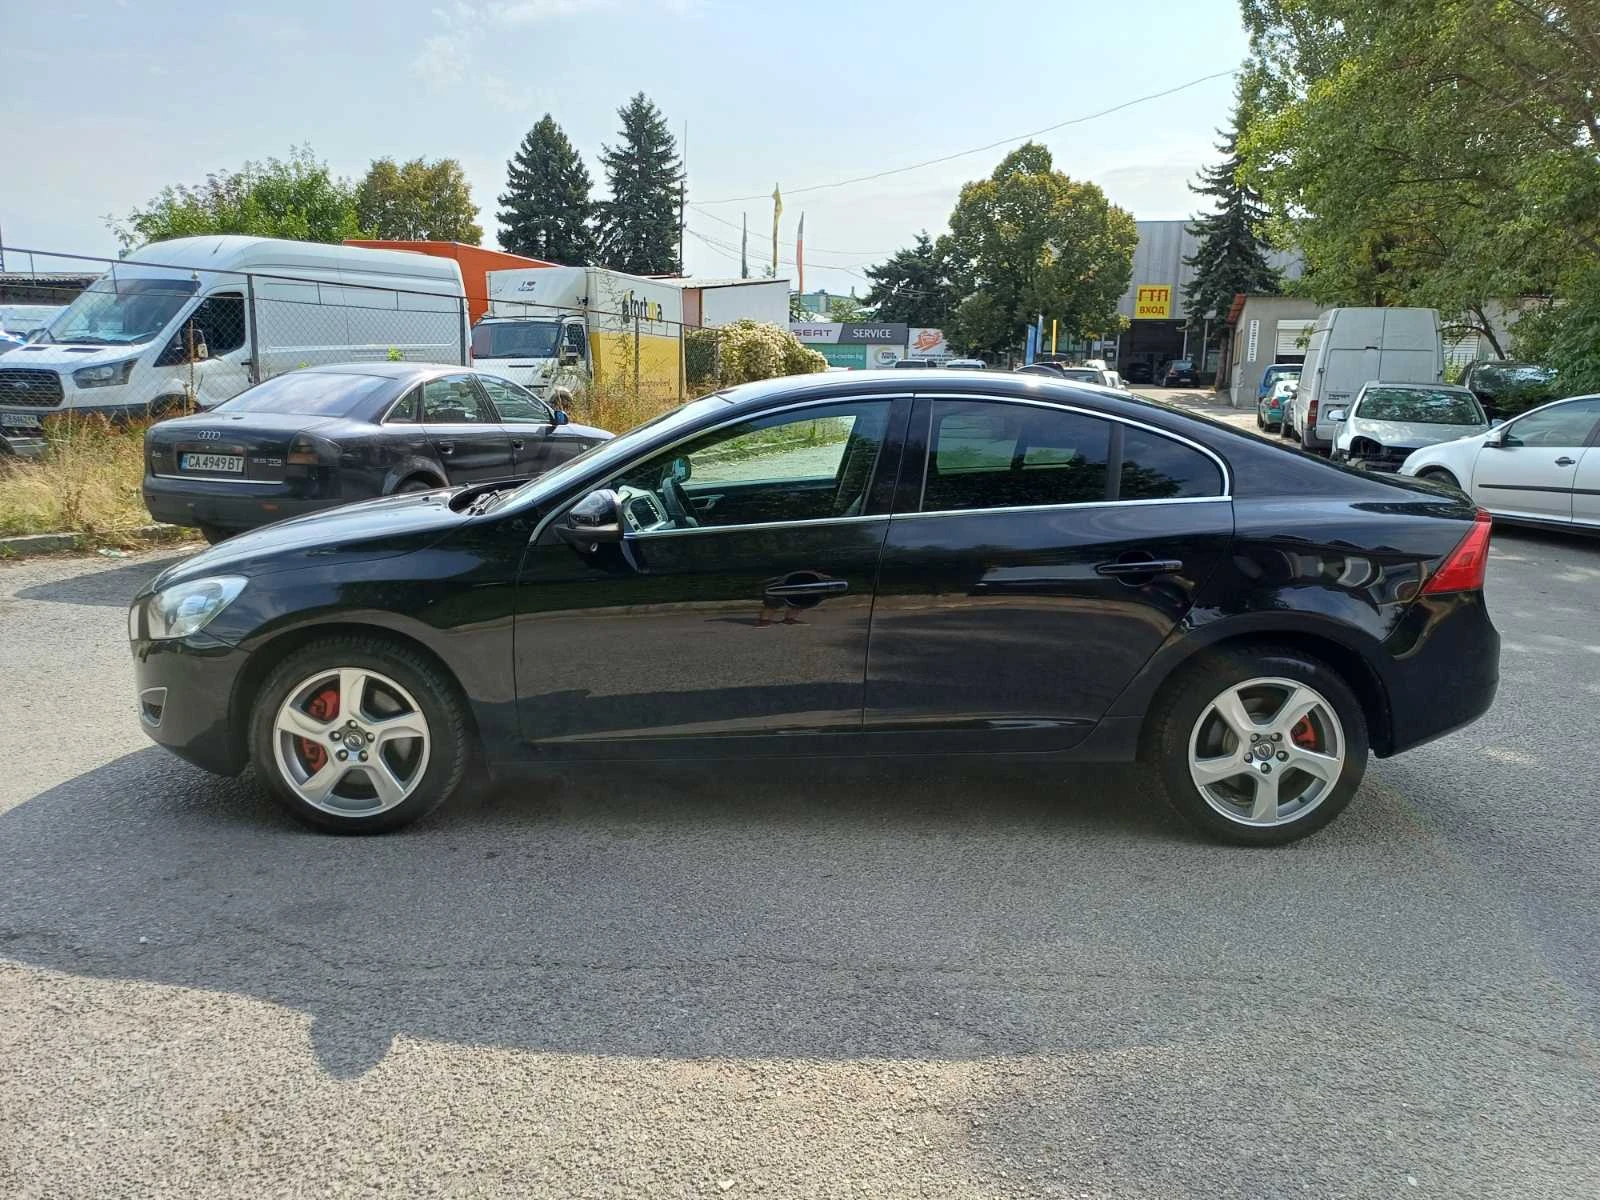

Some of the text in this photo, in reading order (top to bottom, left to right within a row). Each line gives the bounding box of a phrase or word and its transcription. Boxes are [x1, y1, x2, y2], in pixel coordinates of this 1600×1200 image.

[1138, 288, 1169, 302] ГТП
[1139, 305, 1165, 316] ВХОД
[792, 329, 892, 339] SEAT SERVICE
